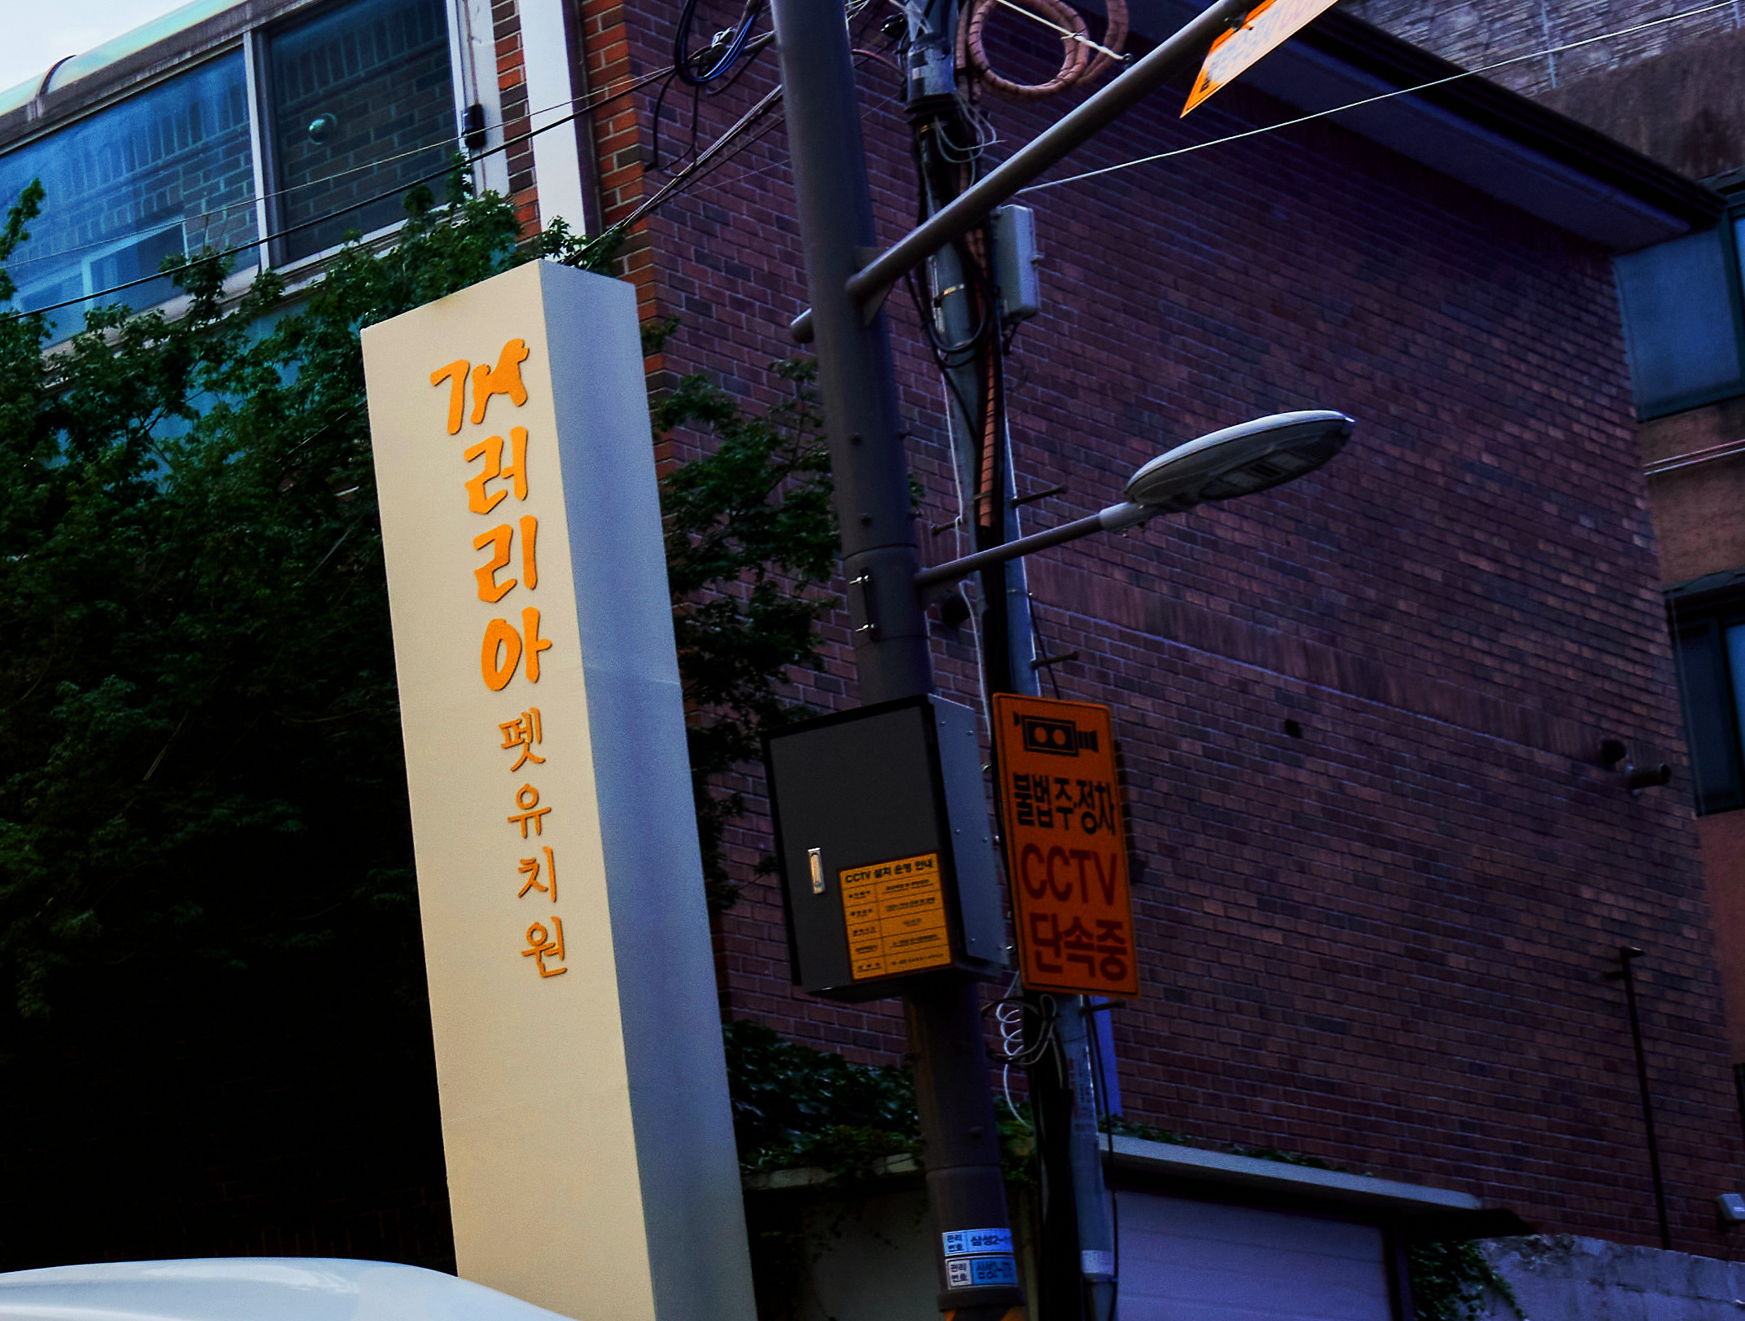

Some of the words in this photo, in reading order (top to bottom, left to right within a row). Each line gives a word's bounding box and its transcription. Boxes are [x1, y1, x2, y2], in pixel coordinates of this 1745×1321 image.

[500, 707, 568, 979] 펫유치원
[1021, 842, 1117, 906] CCTV
[845, 871, 871, 884] CCTV
[1029, 912, 1128, 982] 단속중
